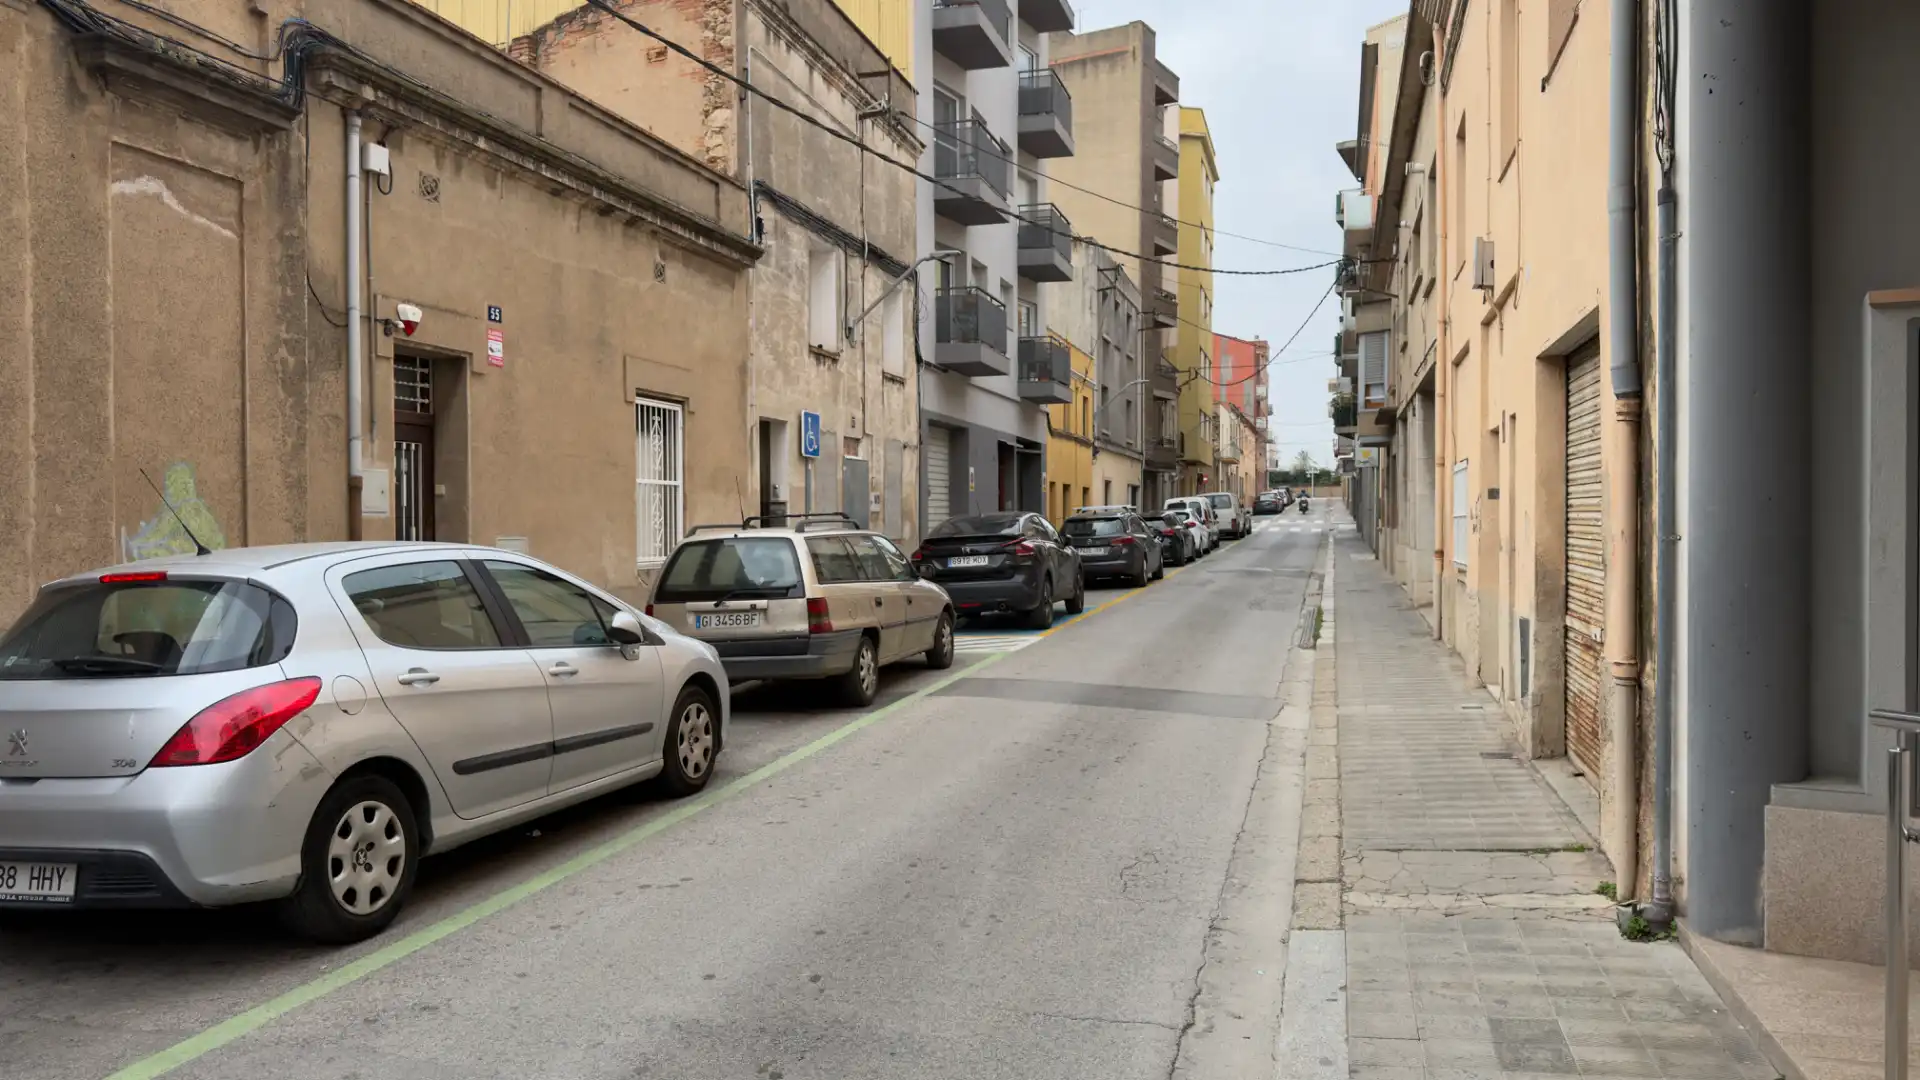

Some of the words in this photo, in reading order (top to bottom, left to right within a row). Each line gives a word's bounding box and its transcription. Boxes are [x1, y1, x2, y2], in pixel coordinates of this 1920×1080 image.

[490, 308, 500, 320] 55
[701, 615, 712, 628] GI
[111, 758, 137, 768] 308
[28, 865, 67, 892] HHY
